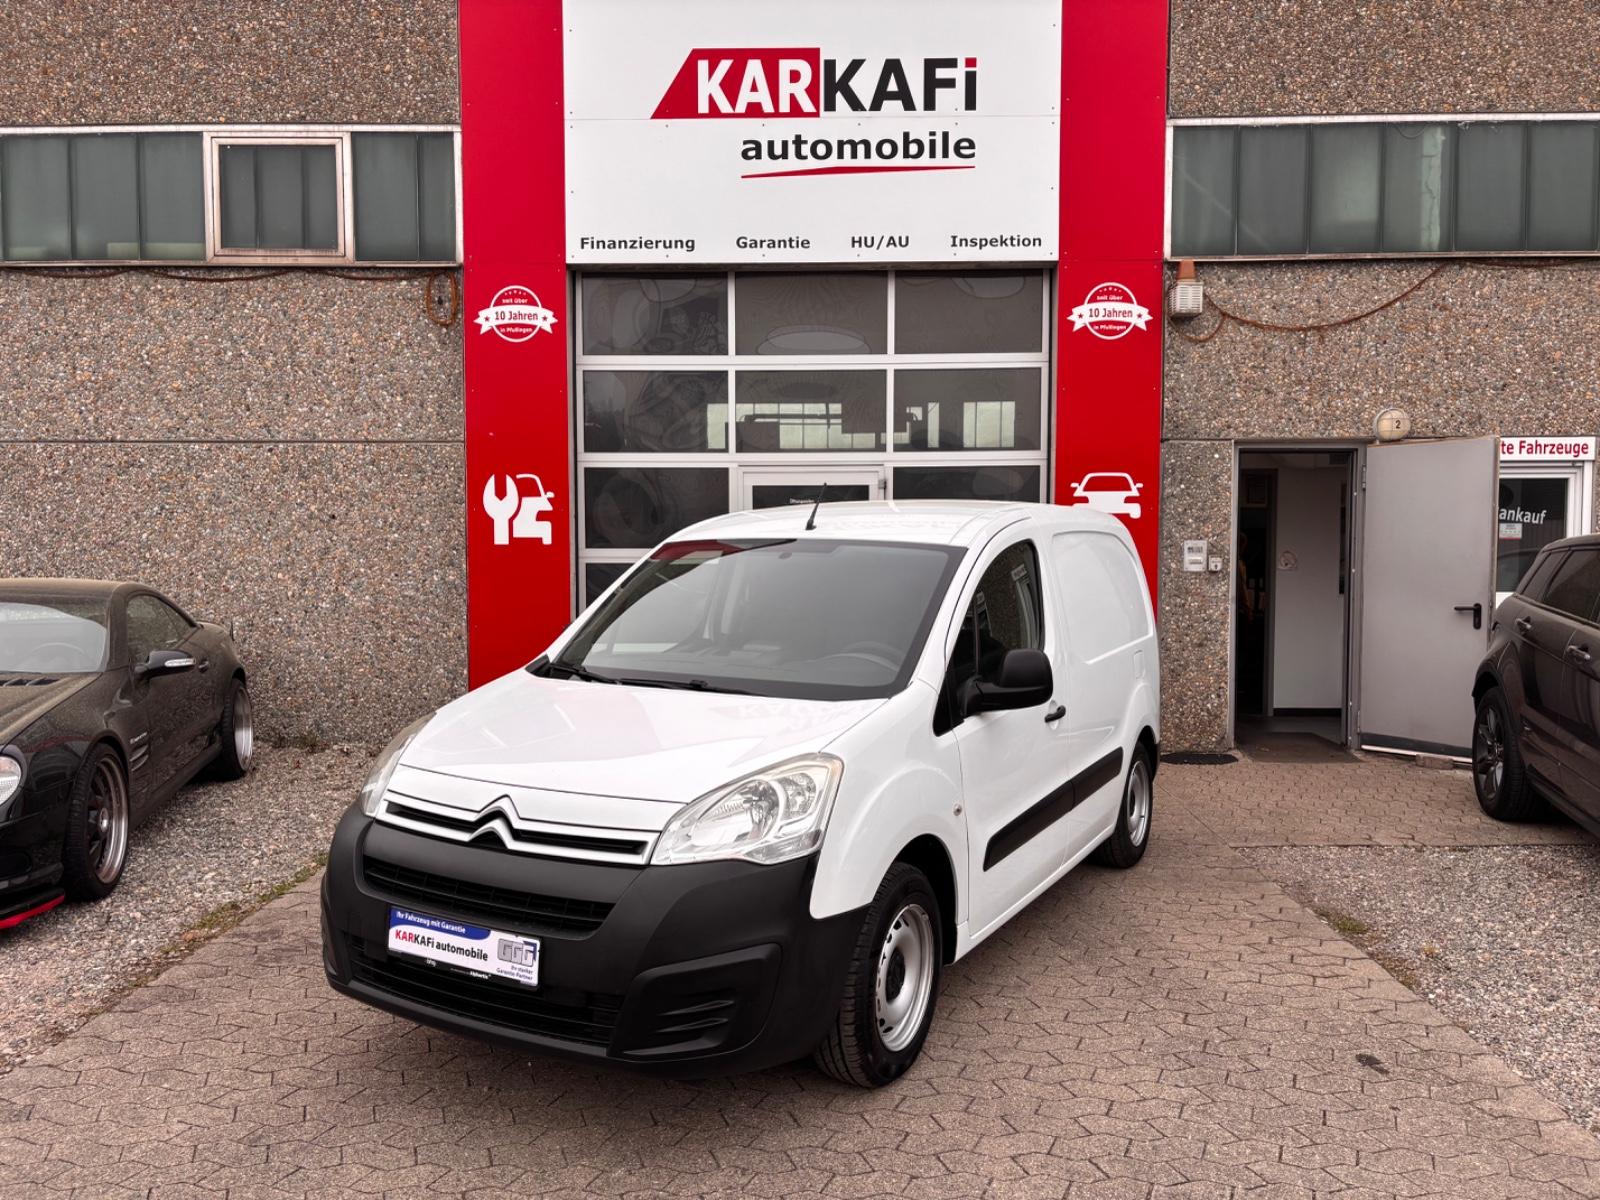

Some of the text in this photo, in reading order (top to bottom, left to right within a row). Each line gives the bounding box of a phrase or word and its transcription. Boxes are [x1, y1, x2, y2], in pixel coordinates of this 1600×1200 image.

[696, 57, 977, 114] KARKAFi
[741, 131, 976, 160] automobile
[580, 236, 695, 252] Finanzierung
[736, 236, 811, 249] Garantie
[851, 235, 910, 250] HU/AU
[950, 234, 1042, 250] Inspektion
[495, 311, 538, 321] 10 Jahren
[1089, 308, 1132, 318] 10 Jahren
[1395, 419, 1402, 430] 2
[1519, 440, 1589, 458] Fahrzeuge
[405, 913, 430, 927] Fahrzeug
[430, 919, 441, 928] mit
[441, 921, 466, 934] Garantie
[395, 929, 489, 961] KARKAFi automobile
